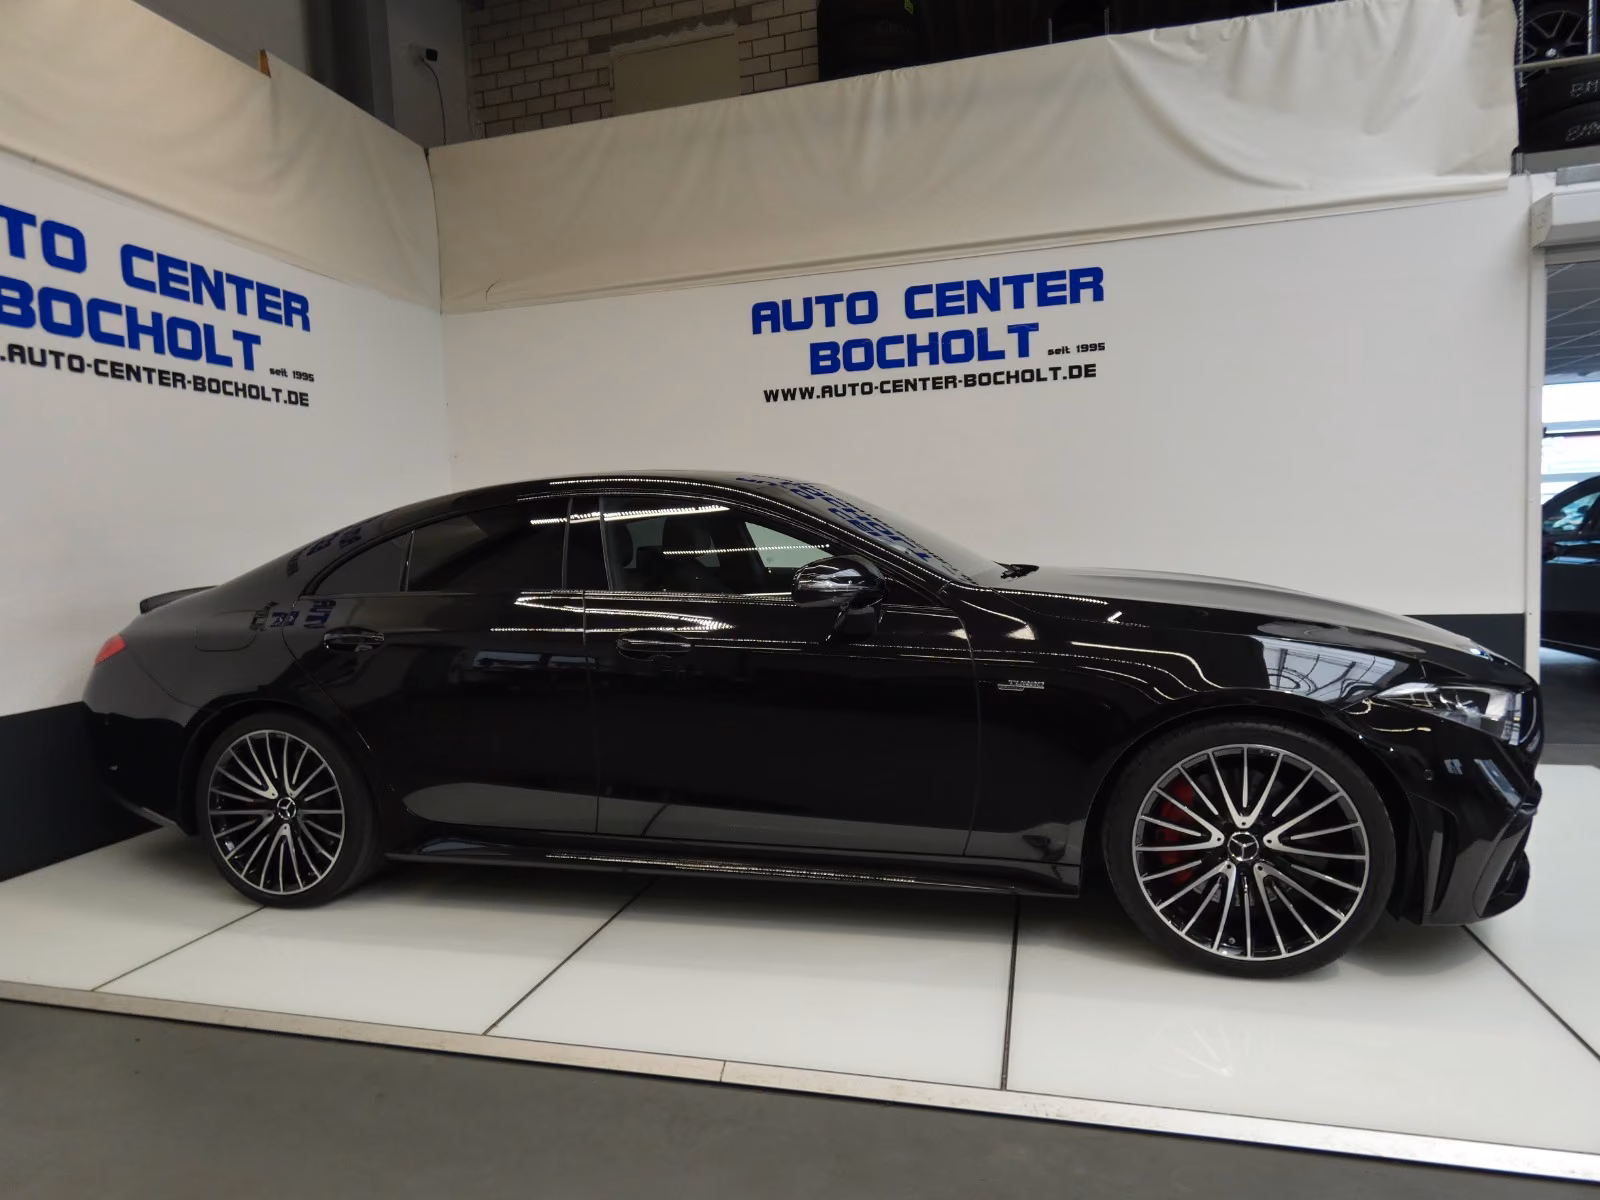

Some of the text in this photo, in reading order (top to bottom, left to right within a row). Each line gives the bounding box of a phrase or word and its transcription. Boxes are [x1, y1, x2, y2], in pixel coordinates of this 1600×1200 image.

[120, 243, 311, 332] CENTER
[751, 266, 1105, 335] AUTO CENTER
[0, 275, 315, 383] BOCHOLT seit 1995
[809, 322, 1106, 375] BOCHOLT seit 1995
[763, 363, 1097, 403] WWW.AUTO-CENTER-BOCHOLT.DE
